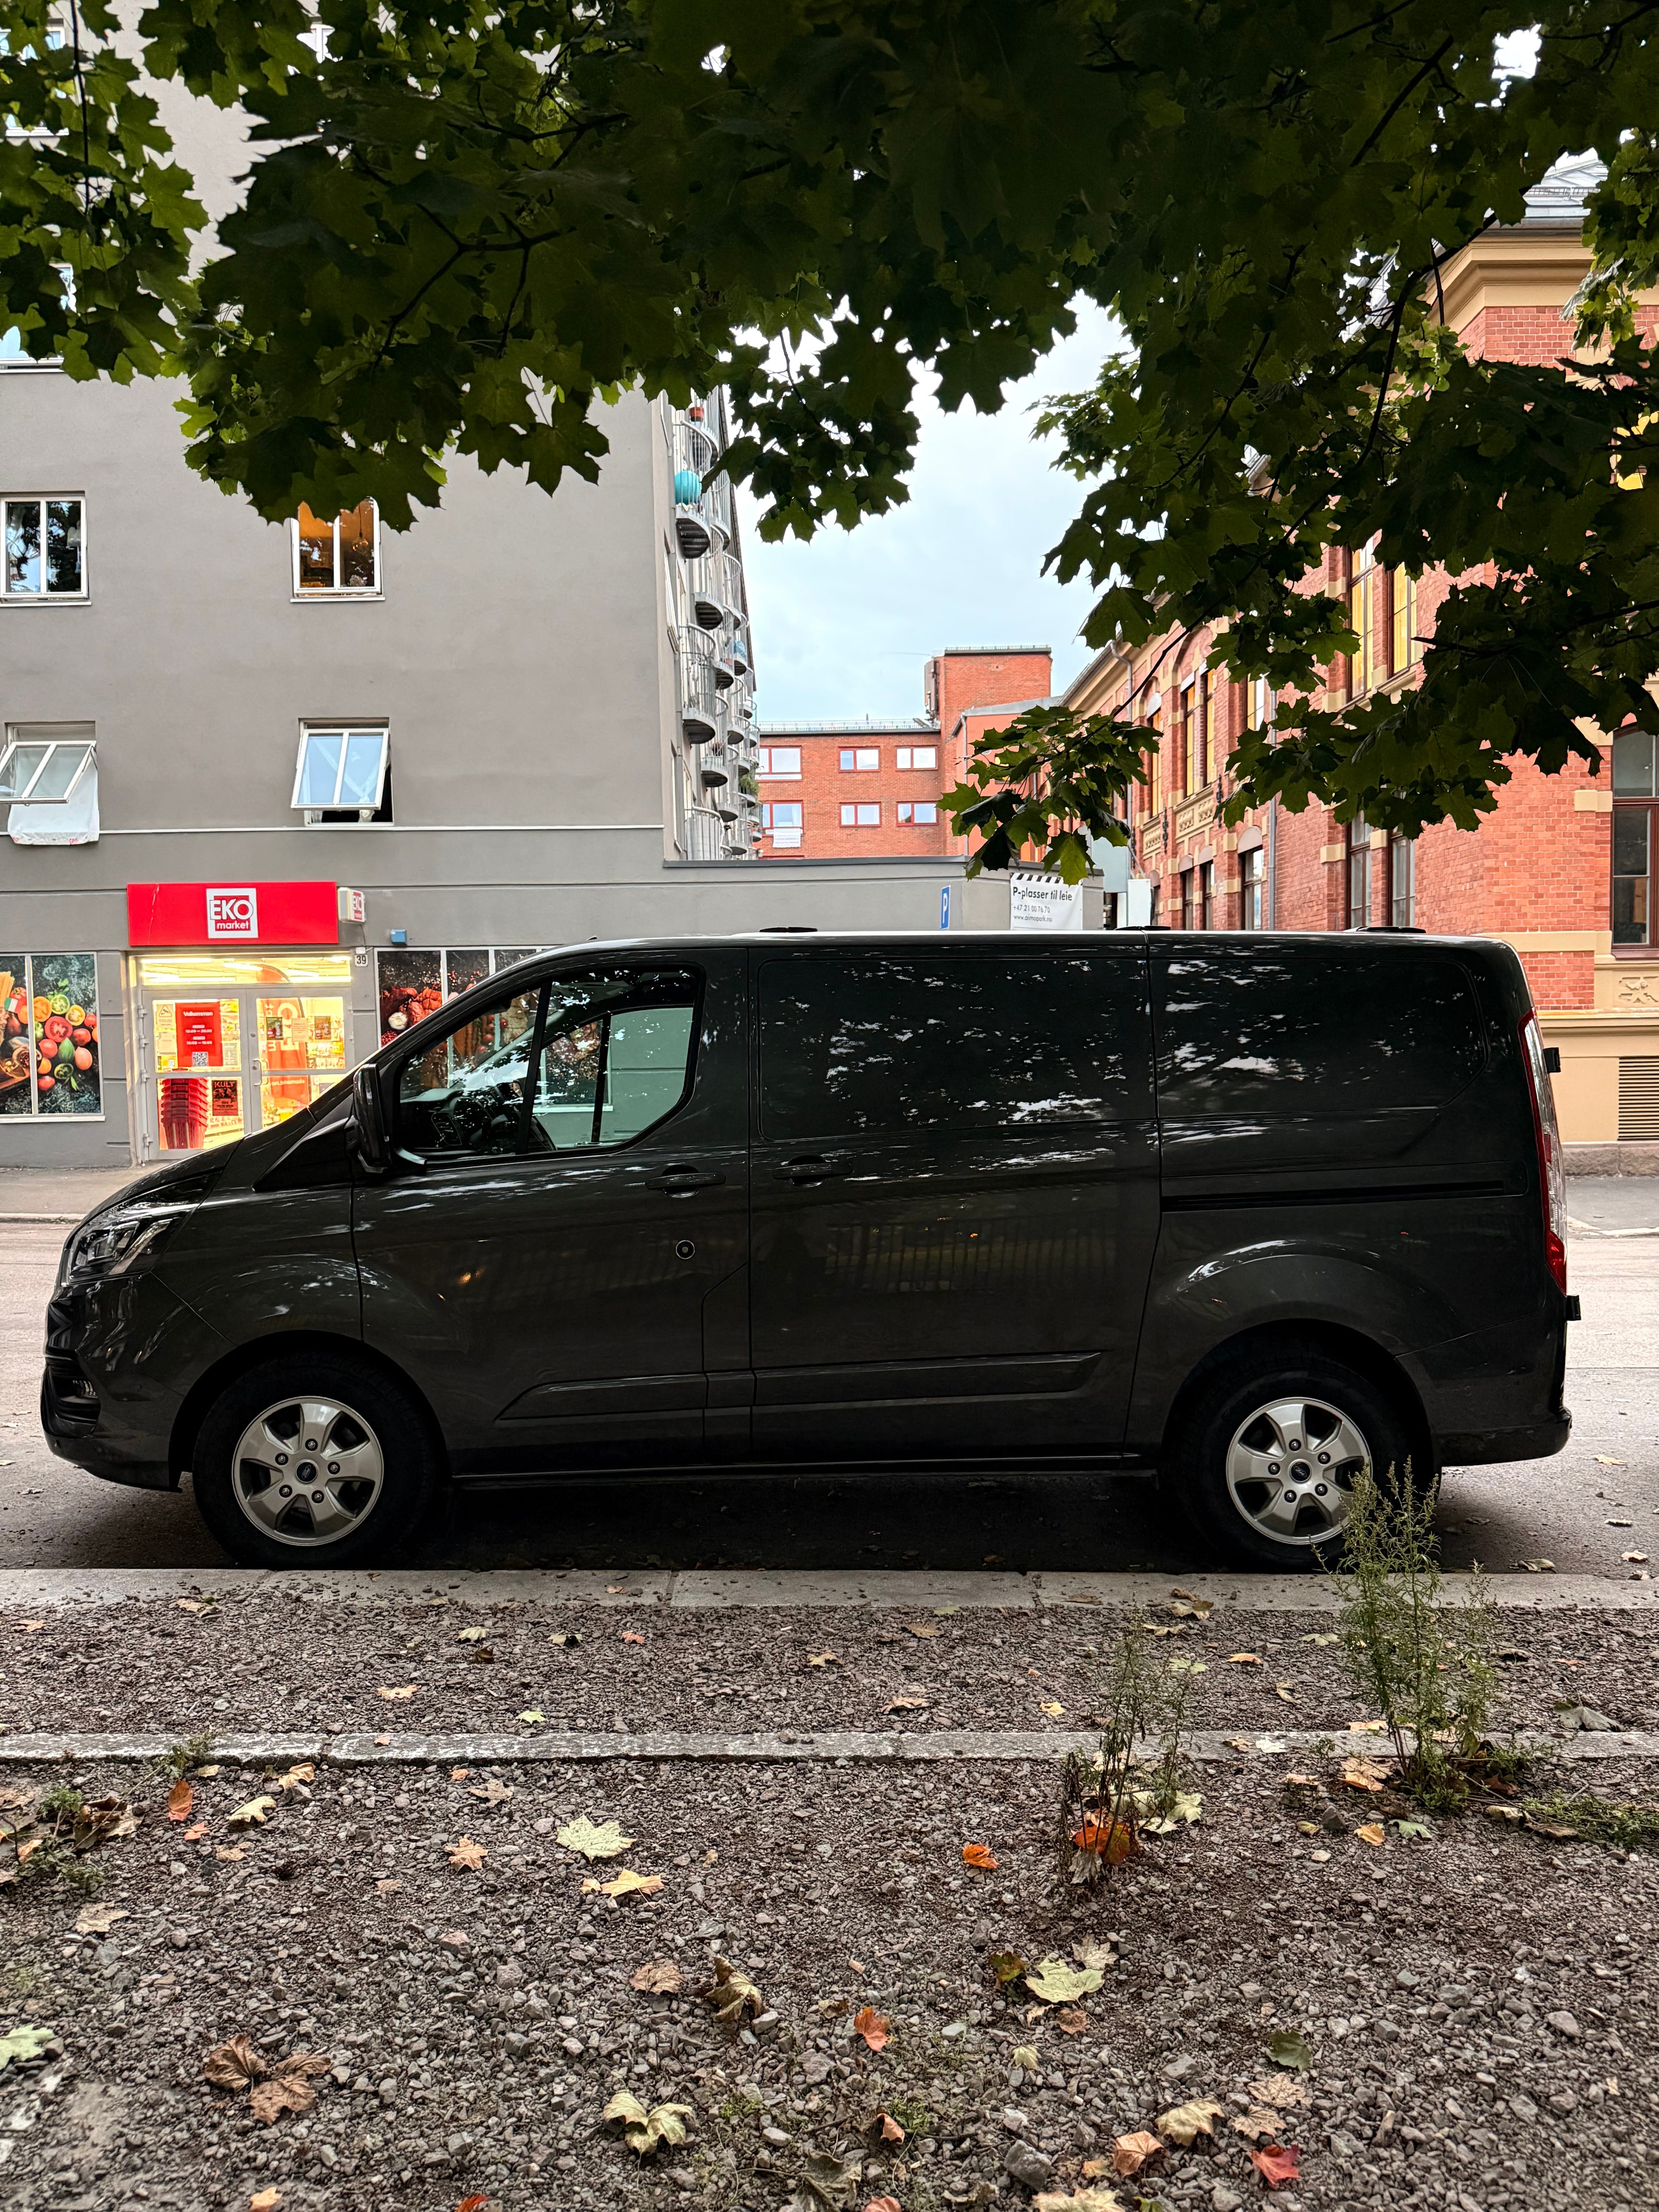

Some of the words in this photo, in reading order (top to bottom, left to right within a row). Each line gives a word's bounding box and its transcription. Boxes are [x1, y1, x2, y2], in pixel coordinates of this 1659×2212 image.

[1013, 886, 1049, 899] P-plasser
[1060, 890, 1072, 901] leie
[210, 898, 254, 920] EKO
[353, 895, 362, 911] EKO
[943, 893, 948, 924] P
[217, 921, 249, 929] market
[357, 955, 366, 965] 39
